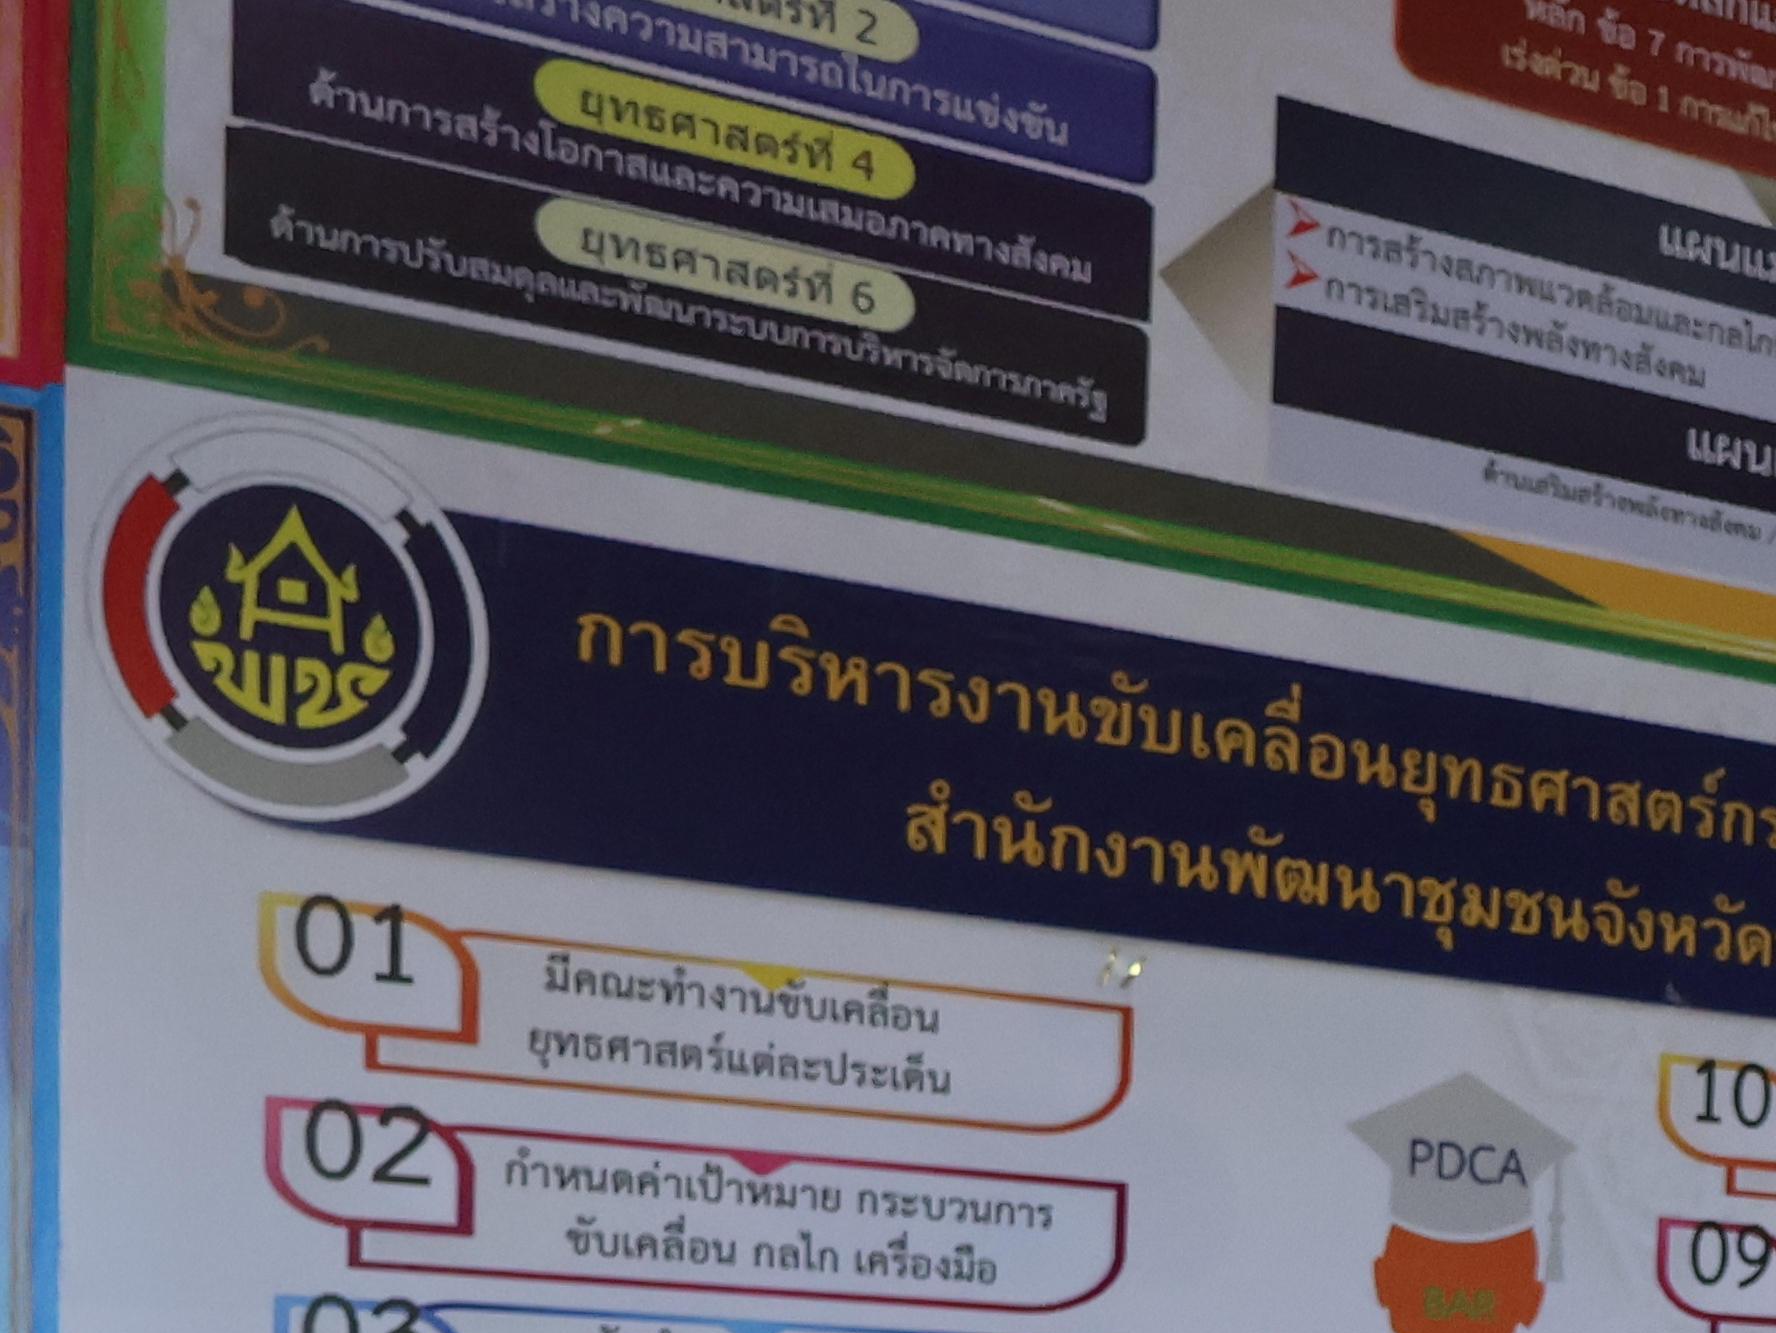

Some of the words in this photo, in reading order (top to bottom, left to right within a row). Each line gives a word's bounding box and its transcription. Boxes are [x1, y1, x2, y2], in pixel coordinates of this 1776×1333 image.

[853, 8, 878, 45] 2
[1648, 28, 1666, 58] 7
[579, 85, 834, 172] ยุทธศาสตร์ที่
[850, 147, 876, 182] 4
[580, 221, 834, 307] ยุทธศาสตร์ที่
[851, 280, 876, 315] 6
[1325, 270, 1707, 391] การเสริมสร้างพลังทางสังคม
[294, 892, 416, 985] 01
[543, 950, 940, 1036] มีคณะทำงานขับเคลื่อน
[527, 1022, 953, 1098] ยุทธศาสตร์แต่ละประเด็น
[1693, 1058, 1773, 1128] 10
[303, 1098, 433, 1188] 02
[1408, 1138, 1529, 1188] PDCA
[505, 1147, 842, 1216] กำหนดค่าเป้าหมาย
[855, 1181, 1054, 1232] กระบวนการ
[565, 1212, 738, 1269] ขับเคลื่อน
[752, 1227, 840, 1276] กลไก
[854, 1231, 998, 1287] เครื่องมือ
[1690, 1220, 1773, 1291] 09
[1422, 1285, 1497, 1323] BAR
